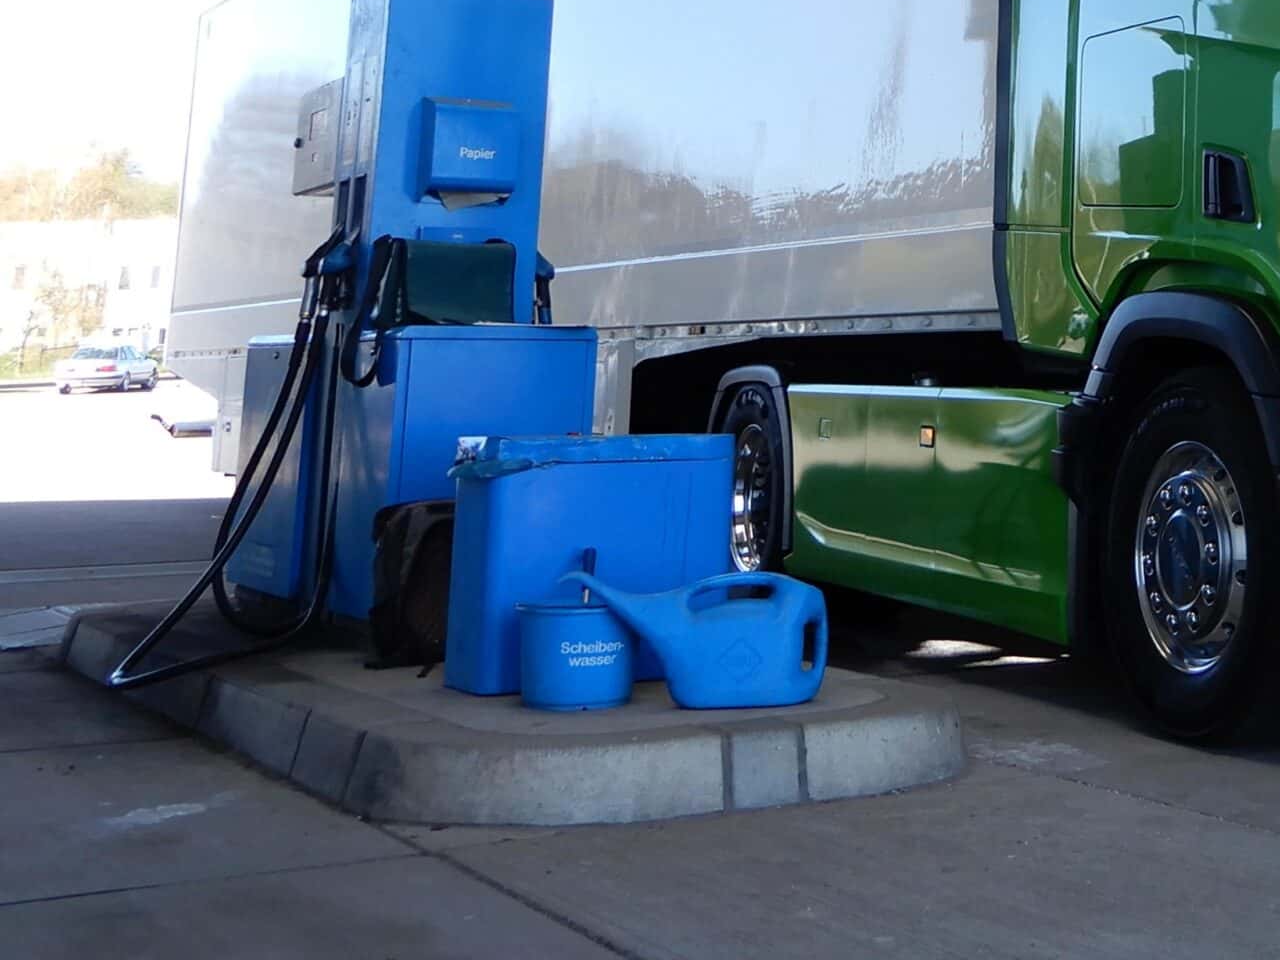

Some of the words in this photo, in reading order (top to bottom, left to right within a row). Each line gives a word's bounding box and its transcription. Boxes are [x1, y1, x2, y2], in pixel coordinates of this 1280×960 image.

[460, 146, 496, 160] Papier
[560, 640, 624, 654] Scheiben-
[568, 654, 616, 666] wasser
